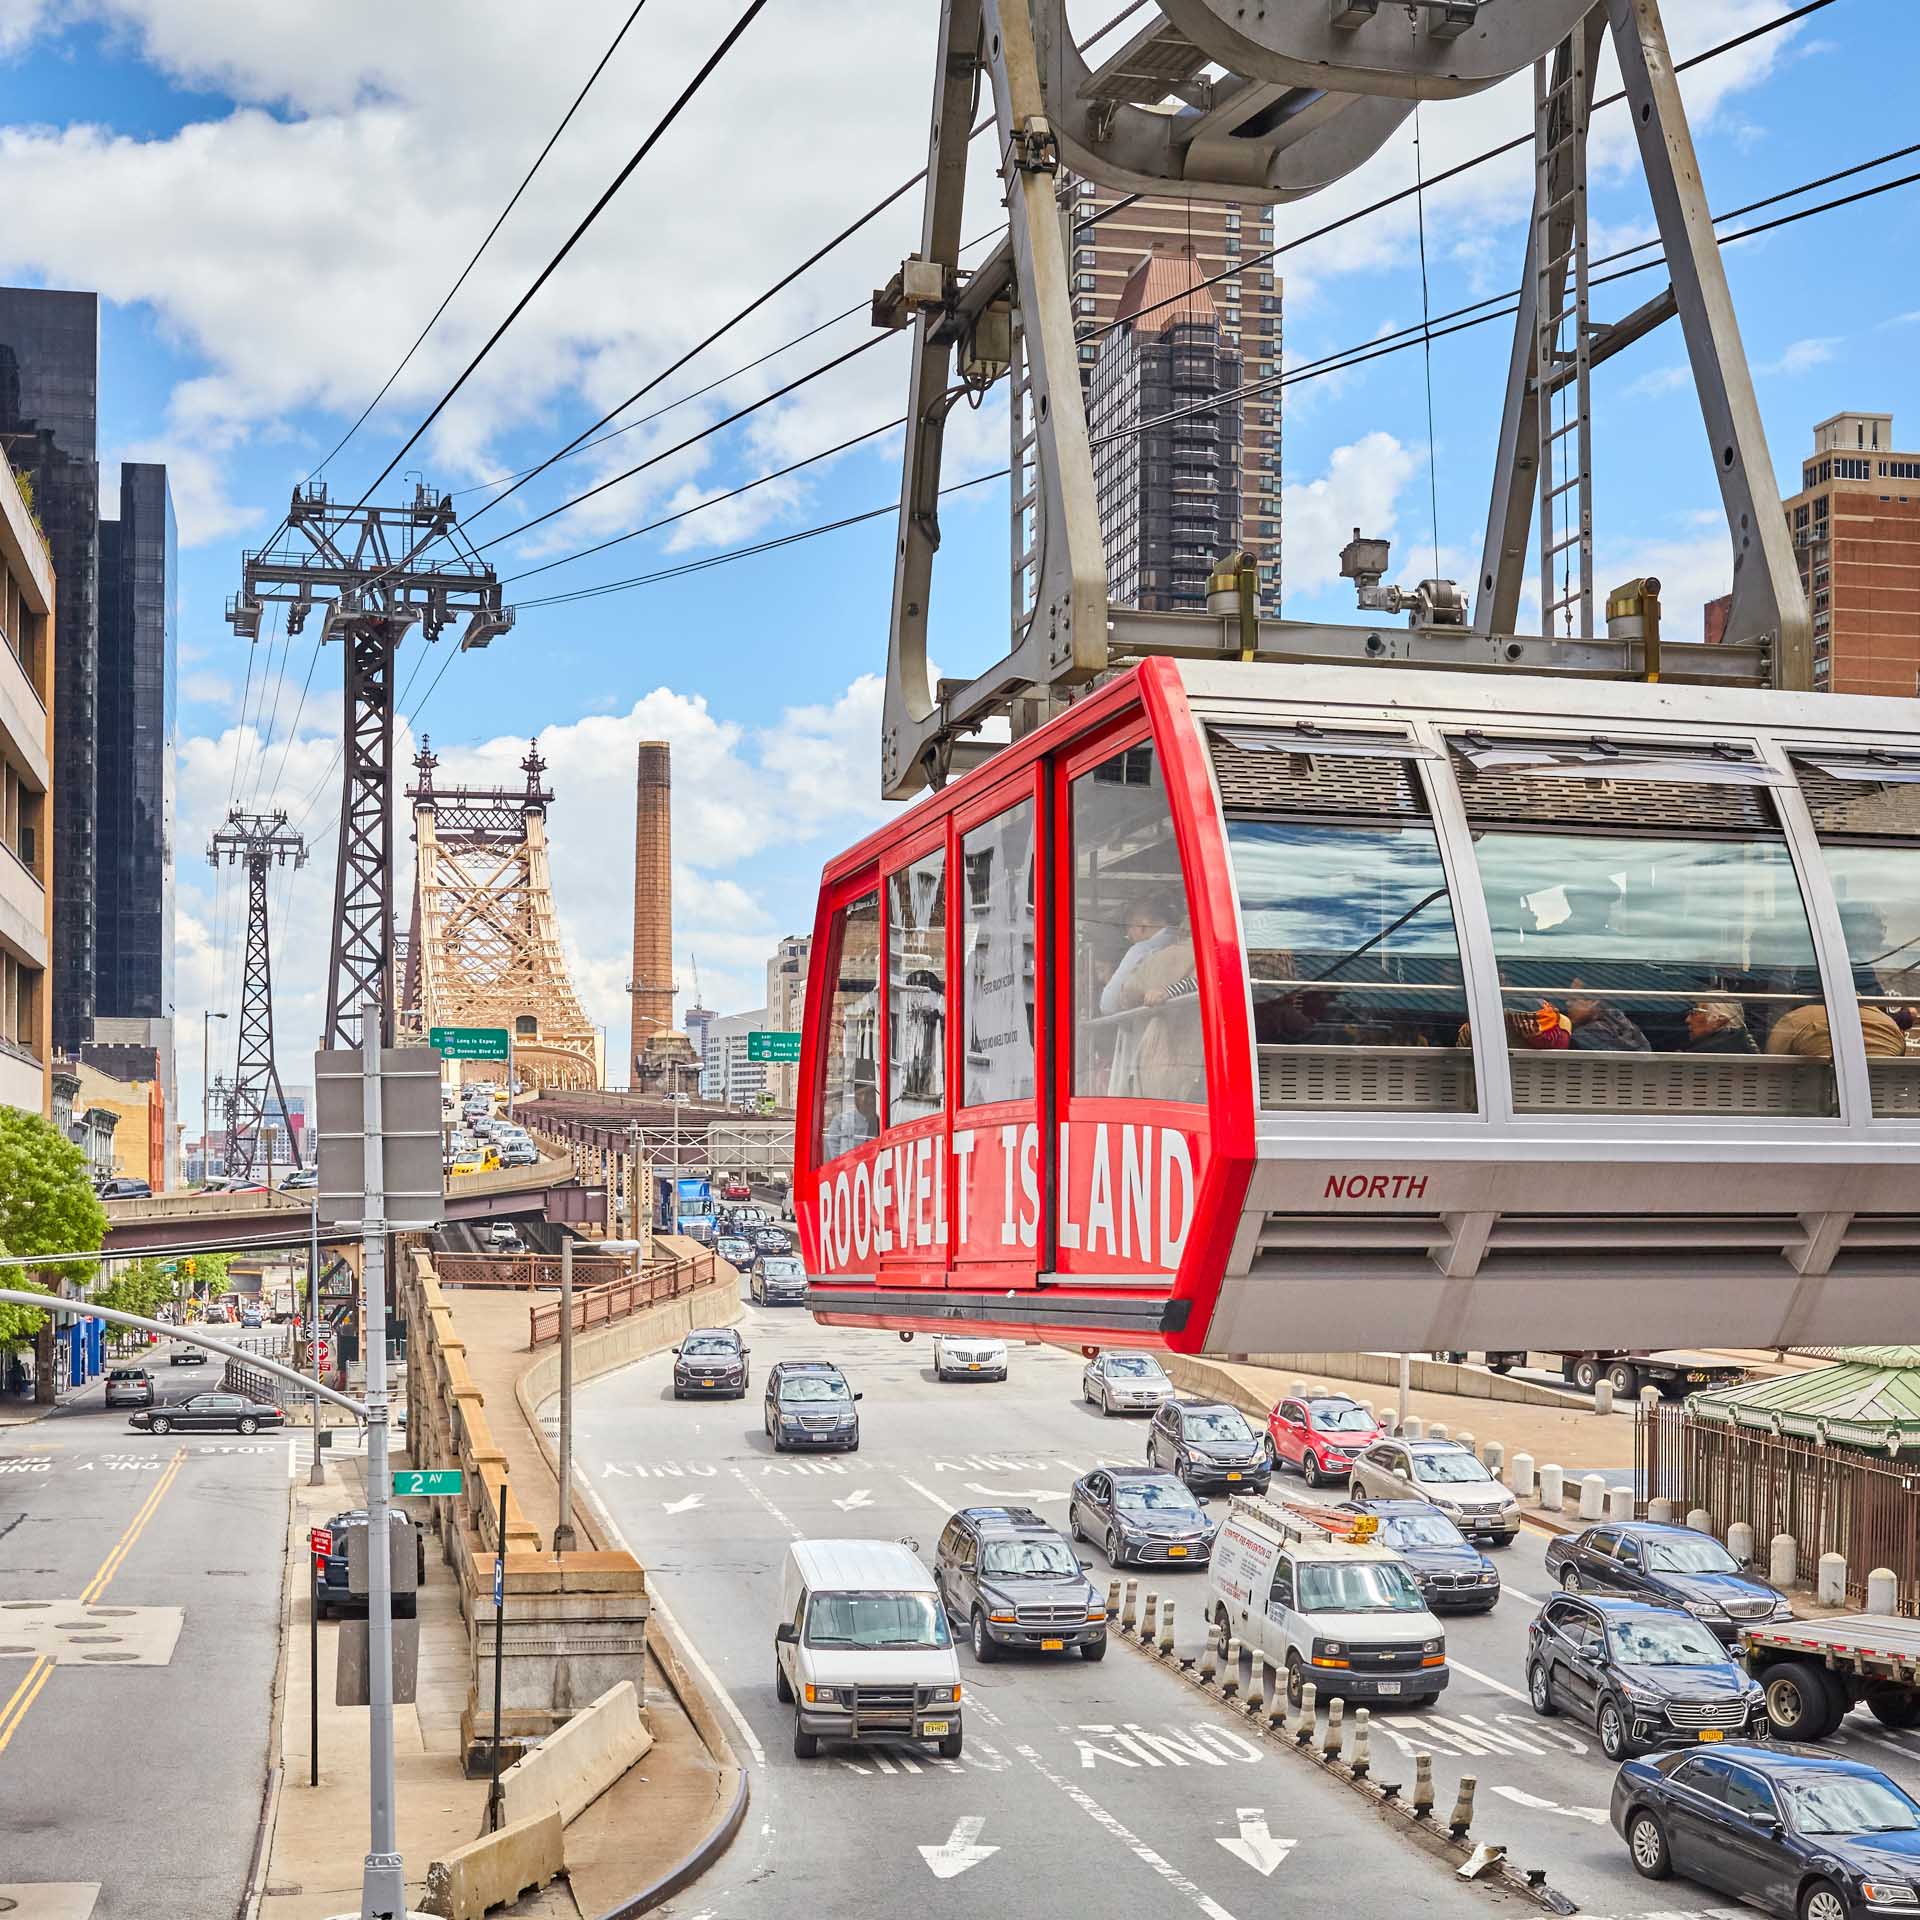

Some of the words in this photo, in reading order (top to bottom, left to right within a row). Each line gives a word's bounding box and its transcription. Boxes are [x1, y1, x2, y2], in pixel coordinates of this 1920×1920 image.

[1323, 1175, 1429, 1199] NORTH
[819, 1130, 975, 1274] ROOSEVELT
[308, 1347, 328, 1356] SOP
[200, 1446, 275, 1454] STOP
[410, 1473, 424, 1493] 2
[429, 1473, 443, 1484] AV
[1074, 1722, 1264, 1768] ONLY
